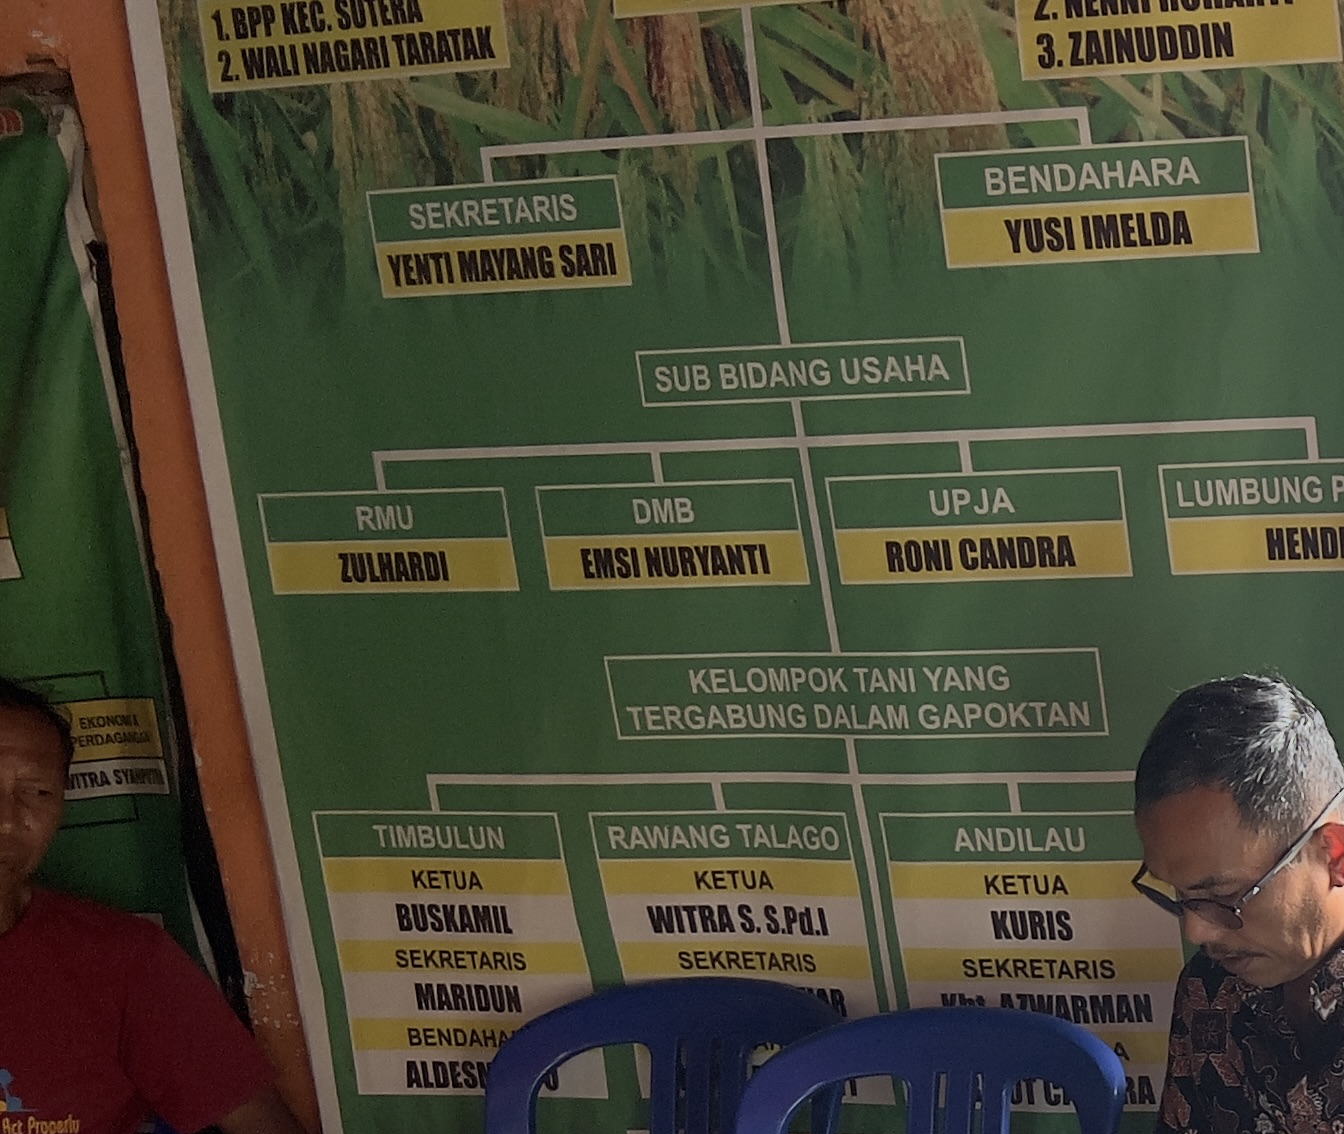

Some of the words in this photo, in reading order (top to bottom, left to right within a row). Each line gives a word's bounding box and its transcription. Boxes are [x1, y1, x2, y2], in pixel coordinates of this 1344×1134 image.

[211, 9, 230, 41] 1.
[232, 5, 276, 40] BPP
[281, 0, 332, 35] KEC.
[335, 0, 423, 30] SUTERA
[217, 50, 239, 82] 2.
[242, 44, 299, 80] WALI
[302, 35, 390, 75] NAGARI
[392, 26, 496, 66] TARATAK
[1037, 33, 1063, 69] 3.
[1068, 22, 1235, 67] ZAINUDDIN
[984, 156, 1201, 197] BENDAHARA
[409, 194, 578, 230] SEKRETARIS
[1005, 216, 1075, 254] YUSI
[1081, 210, 1193, 250] IMELDA
[386, 250, 454, 289] YENTI
[458, 244, 554, 284] MAYANG
[559, 242, 618, 279] SARI
[654, 364, 711, 394] SUB
[718, 358, 831, 390] BIDANG
[840, 352, 949, 385] USAHA
[928, 487, 1015, 517] UPJA
[1176, 476, 1323, 508] LUMBUNG
[356, 505, 414, 531] RMU
[632, 498, 695, 525] DMB
[337, 551, 449, 583] ZULHARDI
[580, 547, 640, 580] EMSI
[646, 543, 770, 578] NURYANTI
[885, 540, 951, 574] RONI
[958, 535, 1076, 571] CANDRA
[688, 667, 848, 694] KELOMPOK
[854, 668, 915, 693] TANI
[922, 665, 1011, 693] YANG
[626, 704, 808, 732] TERGABUNG
[815, 703, 909, 731] DALAM
[916, 701, 1090, 731] GAPOKTAN
[372, 824, 506, 850] TIMBULUN
[607, 825, 730, 850] RAWANG
[736, 824, 840, 852] TALAGO
[954, 827, 1086, 853] ANDILAU
[411, 870, 483, 891] KETUA
[694, 870, 774, 891] KETUA
[984, 874, 1068, 896] KETUA
[395, 903, 513, 936] BUSKAMIL
[647, 905, 734, 936] WITRA
[740, 905, 762, 935] S.
[766, 905, 829, 937] S.Pd.I
[991, 910, 1074, 942] KURIS
[395, 949, 527, 972] SEKRETARIS
[678, 950, 817, 974] SEKRETARIS
[962, 958, 1116, 981] SEKRETARIS
[415, 983, 522, 1013] MARIDUN
[407, 1027, 514, 1049] BENDAHA
